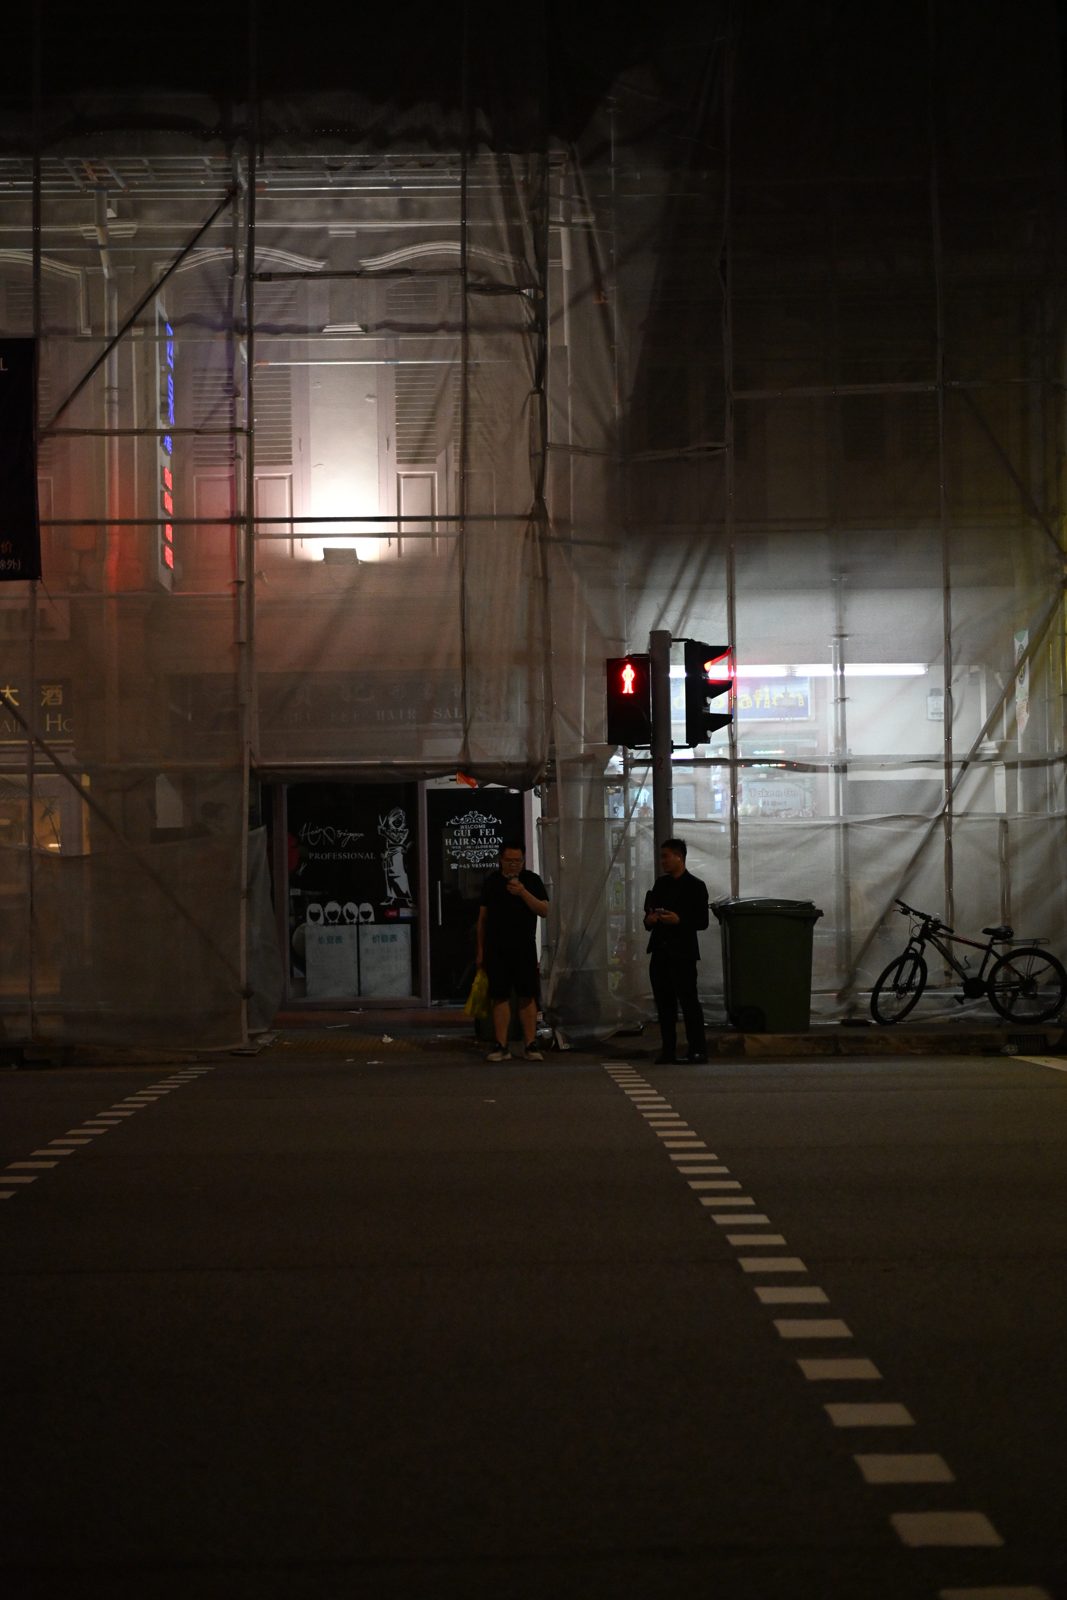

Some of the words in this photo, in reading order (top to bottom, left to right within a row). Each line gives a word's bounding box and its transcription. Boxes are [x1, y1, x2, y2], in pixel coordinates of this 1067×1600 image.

[454, 829, 471, 837] GUI
[480, 828, 495, 836] FEI
[445, 838, 469, 846] HAIR
[471, 837, 503, 845] SALON
[308, 851, 377, 861] PROFESSIONAL
